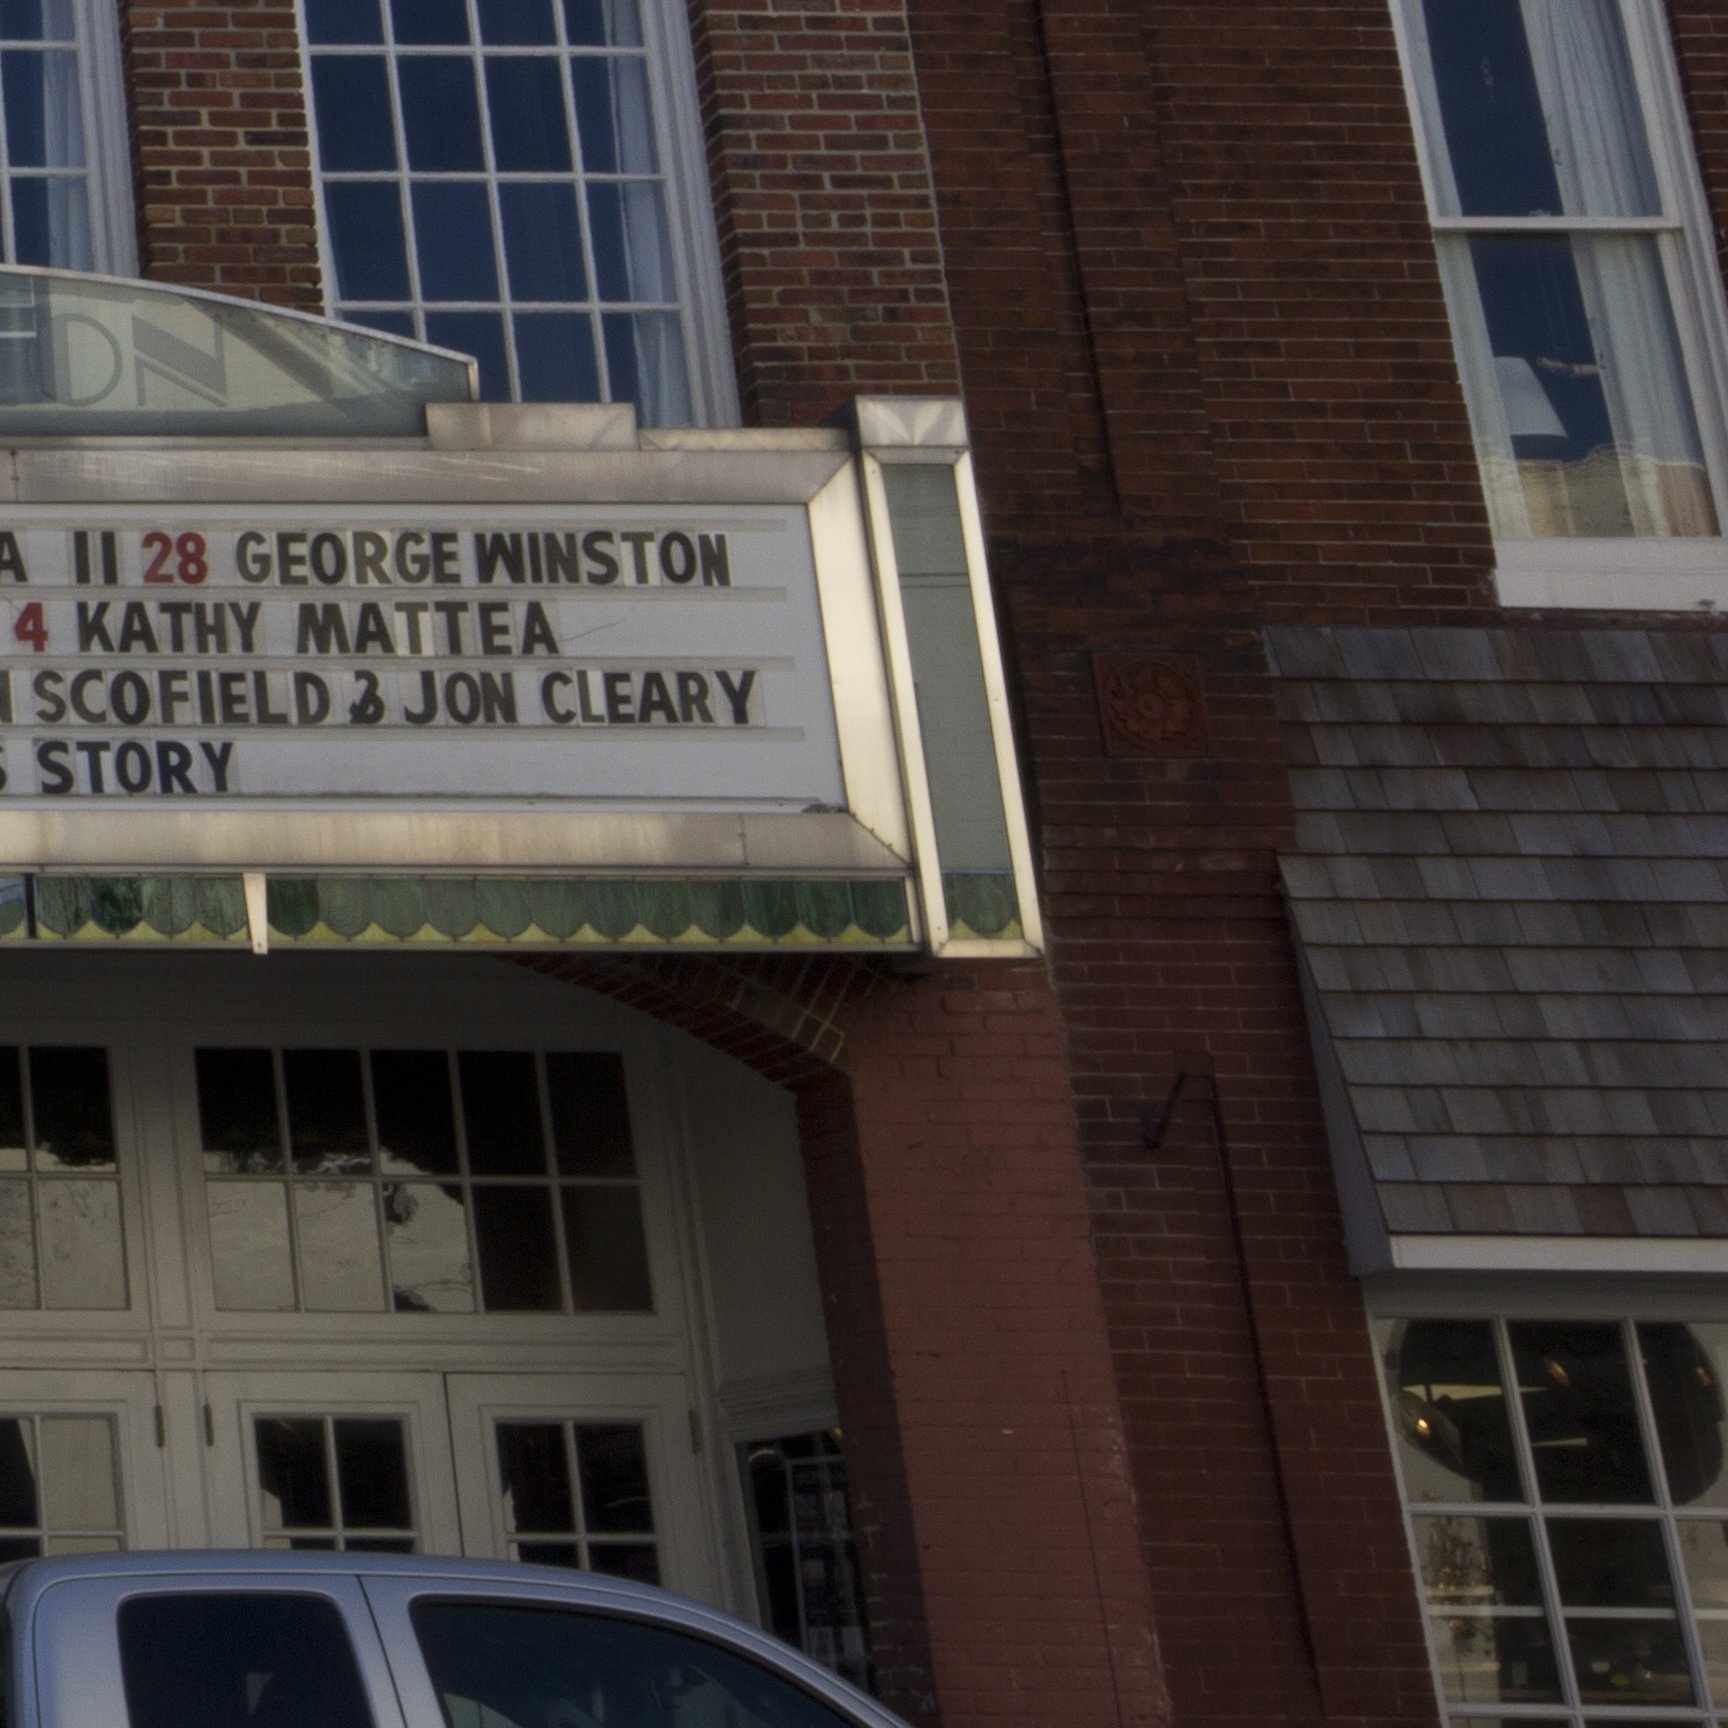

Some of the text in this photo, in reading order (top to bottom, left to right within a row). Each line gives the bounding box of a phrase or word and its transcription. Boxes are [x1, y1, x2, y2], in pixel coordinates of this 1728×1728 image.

[142, 531, 208, 585] 28
[236, 531, 461, 585] GEORGE
[474, 530, 729, 586] WINSTON
[14, 602, 48, 652] 4
[77, 601, 260, 653] KATHY
[297, 601, 559, 658] MATTEA
[34, 669, 330, 728] SCOFIELD
[404, 670, 517, 729] JON
[541, 670, 755, 728] CLEARY
[35, 738, 232, 795] STORY
